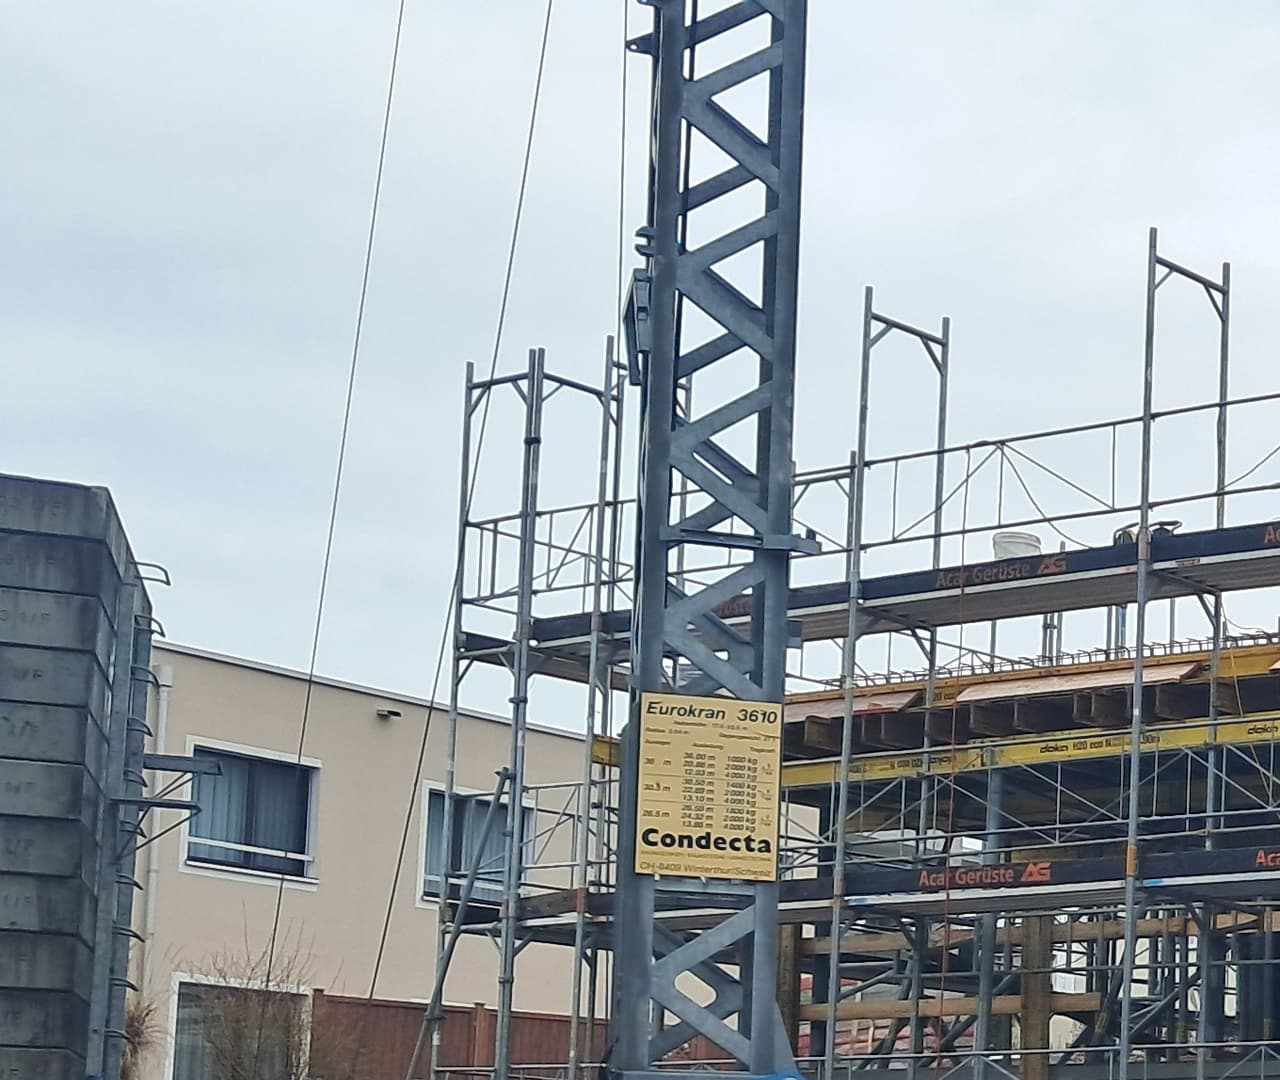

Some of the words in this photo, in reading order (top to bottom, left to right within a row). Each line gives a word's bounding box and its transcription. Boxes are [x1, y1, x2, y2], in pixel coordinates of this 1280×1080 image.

[646, 701, 726, 720] Eurokran
[737, 708, 778, 724] 3610
[641, 827, 772, 853] Condecta
[955, 868, 1013, 885] Gerüste
[1020, 863, 1051, 882] AG
